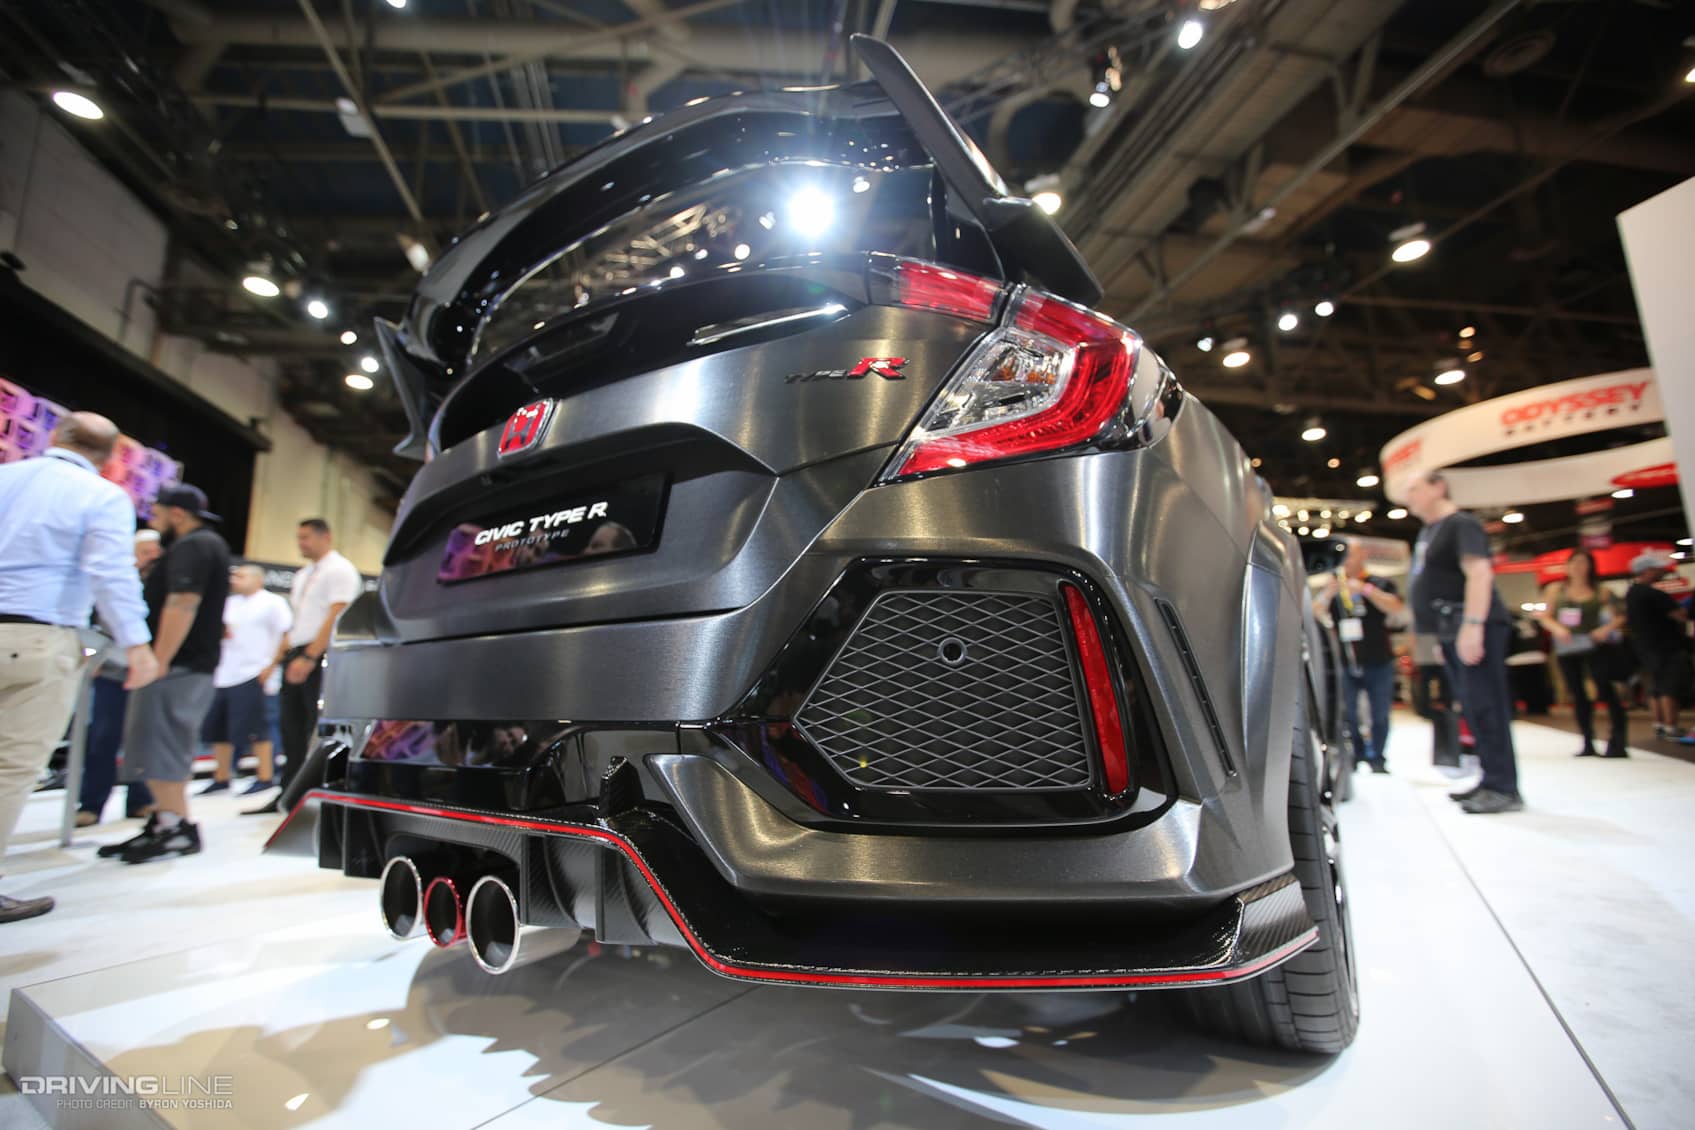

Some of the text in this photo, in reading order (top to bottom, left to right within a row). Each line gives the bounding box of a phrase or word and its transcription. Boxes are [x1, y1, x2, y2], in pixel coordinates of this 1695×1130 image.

[847, 357, 911, 380] R
[1500, 381, 1649, 426] ODYSSEY
[475, 501, 609, 545] CIVIC TYPE R
[495, 528, 570, 552] PROTOTYPE
